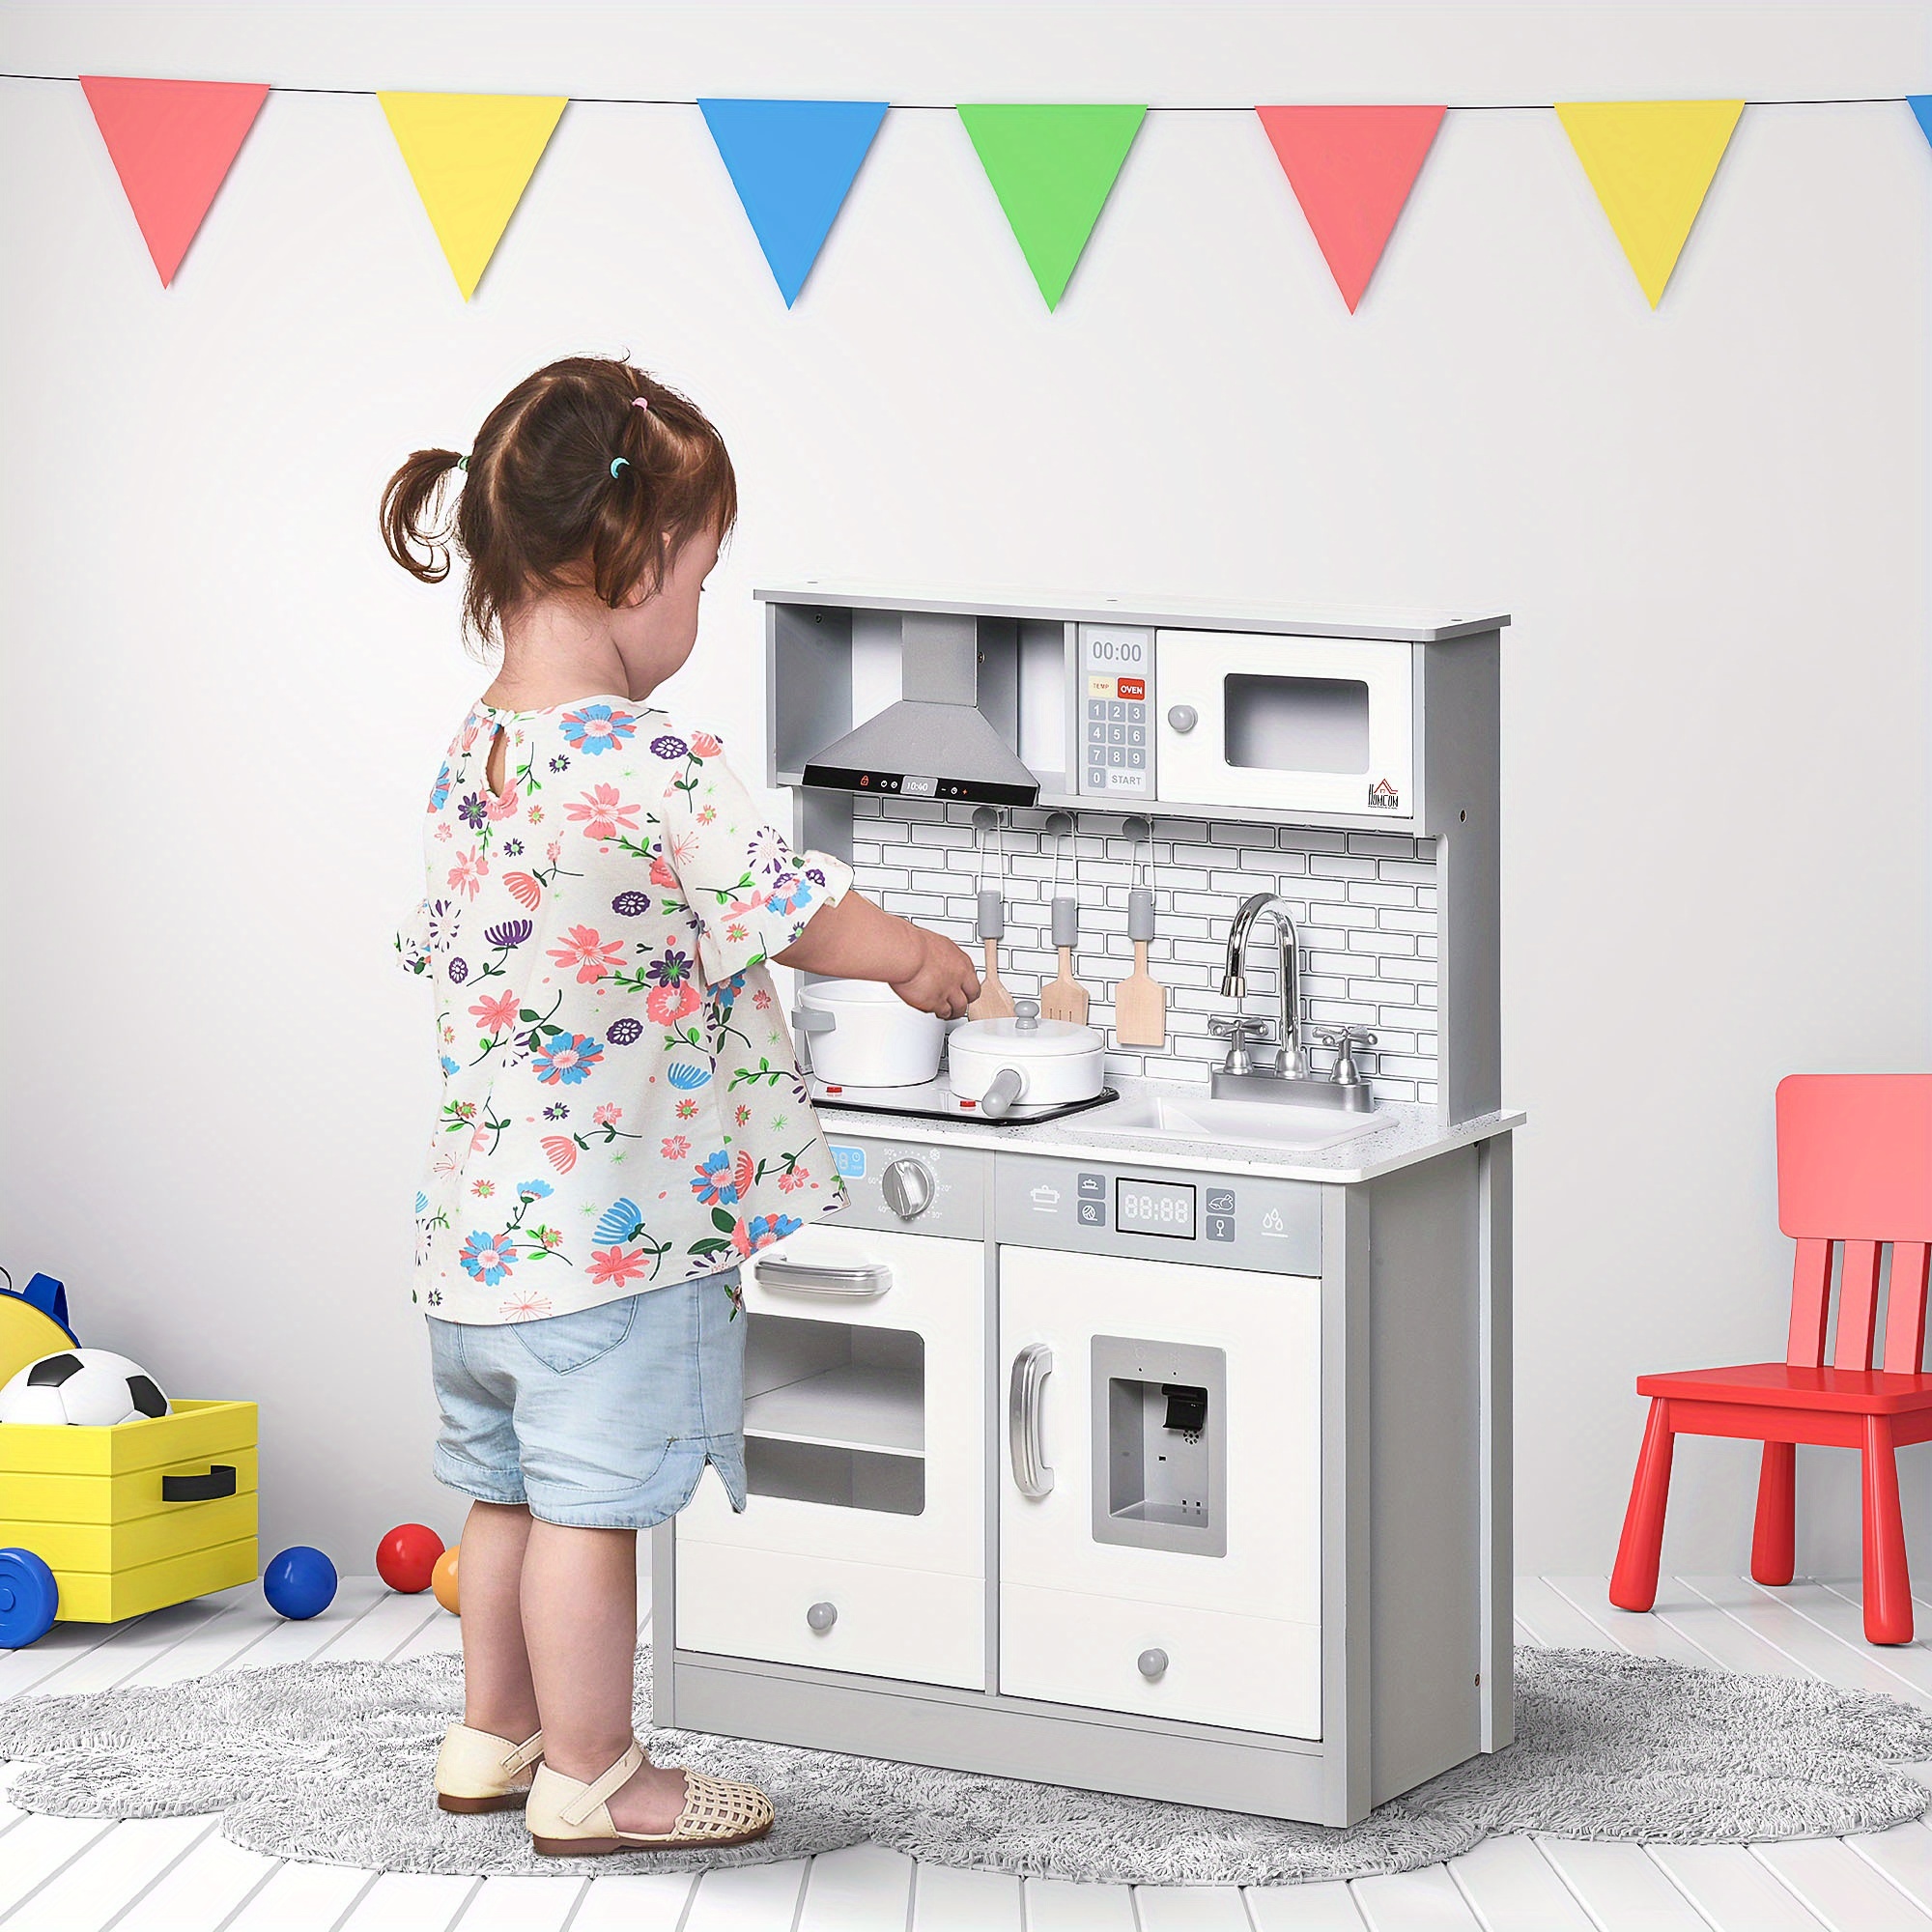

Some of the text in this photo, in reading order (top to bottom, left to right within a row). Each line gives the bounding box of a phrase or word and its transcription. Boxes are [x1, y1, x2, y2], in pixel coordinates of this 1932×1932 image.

[1093, 641, 1142, 662] 00:00
[1121, 685, 1143, 695] OVEN
[1094, 704, 1141, 720] 1 2 3
[1093, 727, 1141, 742] 4 5 6
[1094, 750, 1140, 764] 7 8 9
[1094, 772, 1142, 785] 0 START
[1124, 1194, 1188, 1223] 88:88
